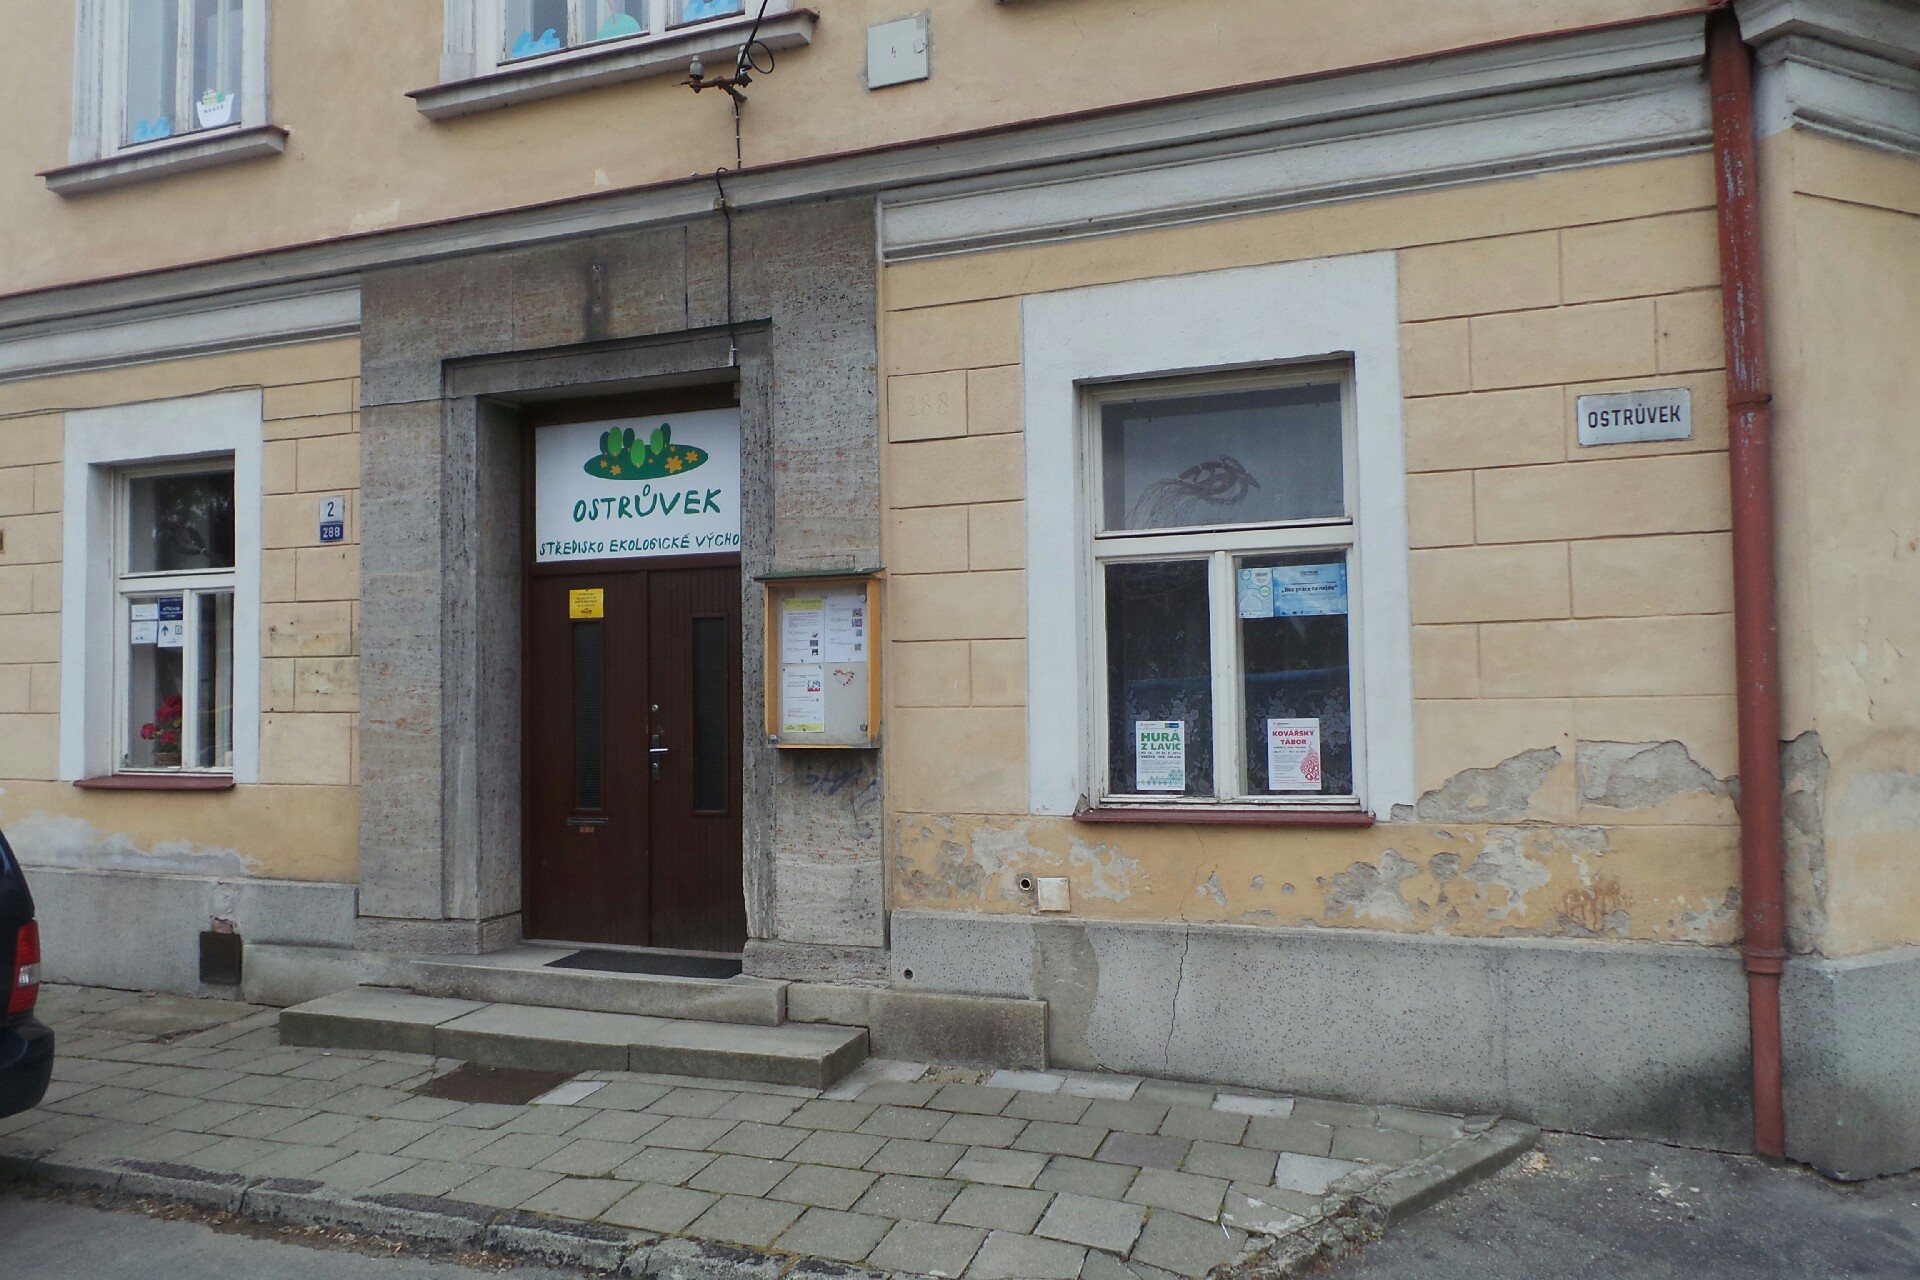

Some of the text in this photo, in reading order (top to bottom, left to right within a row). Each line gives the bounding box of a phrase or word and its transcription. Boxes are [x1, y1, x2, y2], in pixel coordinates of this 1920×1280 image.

[1588, 403, 1681, 429] OSTRŮVEK
[327, 501, 335, 517] 2
[573, 484, 722, 522] OSTRŮVEK
[322, 526, 341, 538] 288
[539, 540, 604, 556] STŘEDISKO
[609, 533, 690, 553] EKOLOGICKÉ
[1140, 729, 1181, 742] HURÁ
[1272, 728, 1315, 737] KOVÁŘSKÝ
[1151, 743, 1181, 751] LAVIC
[1280, 737, 1307, 745] TÁBOR
